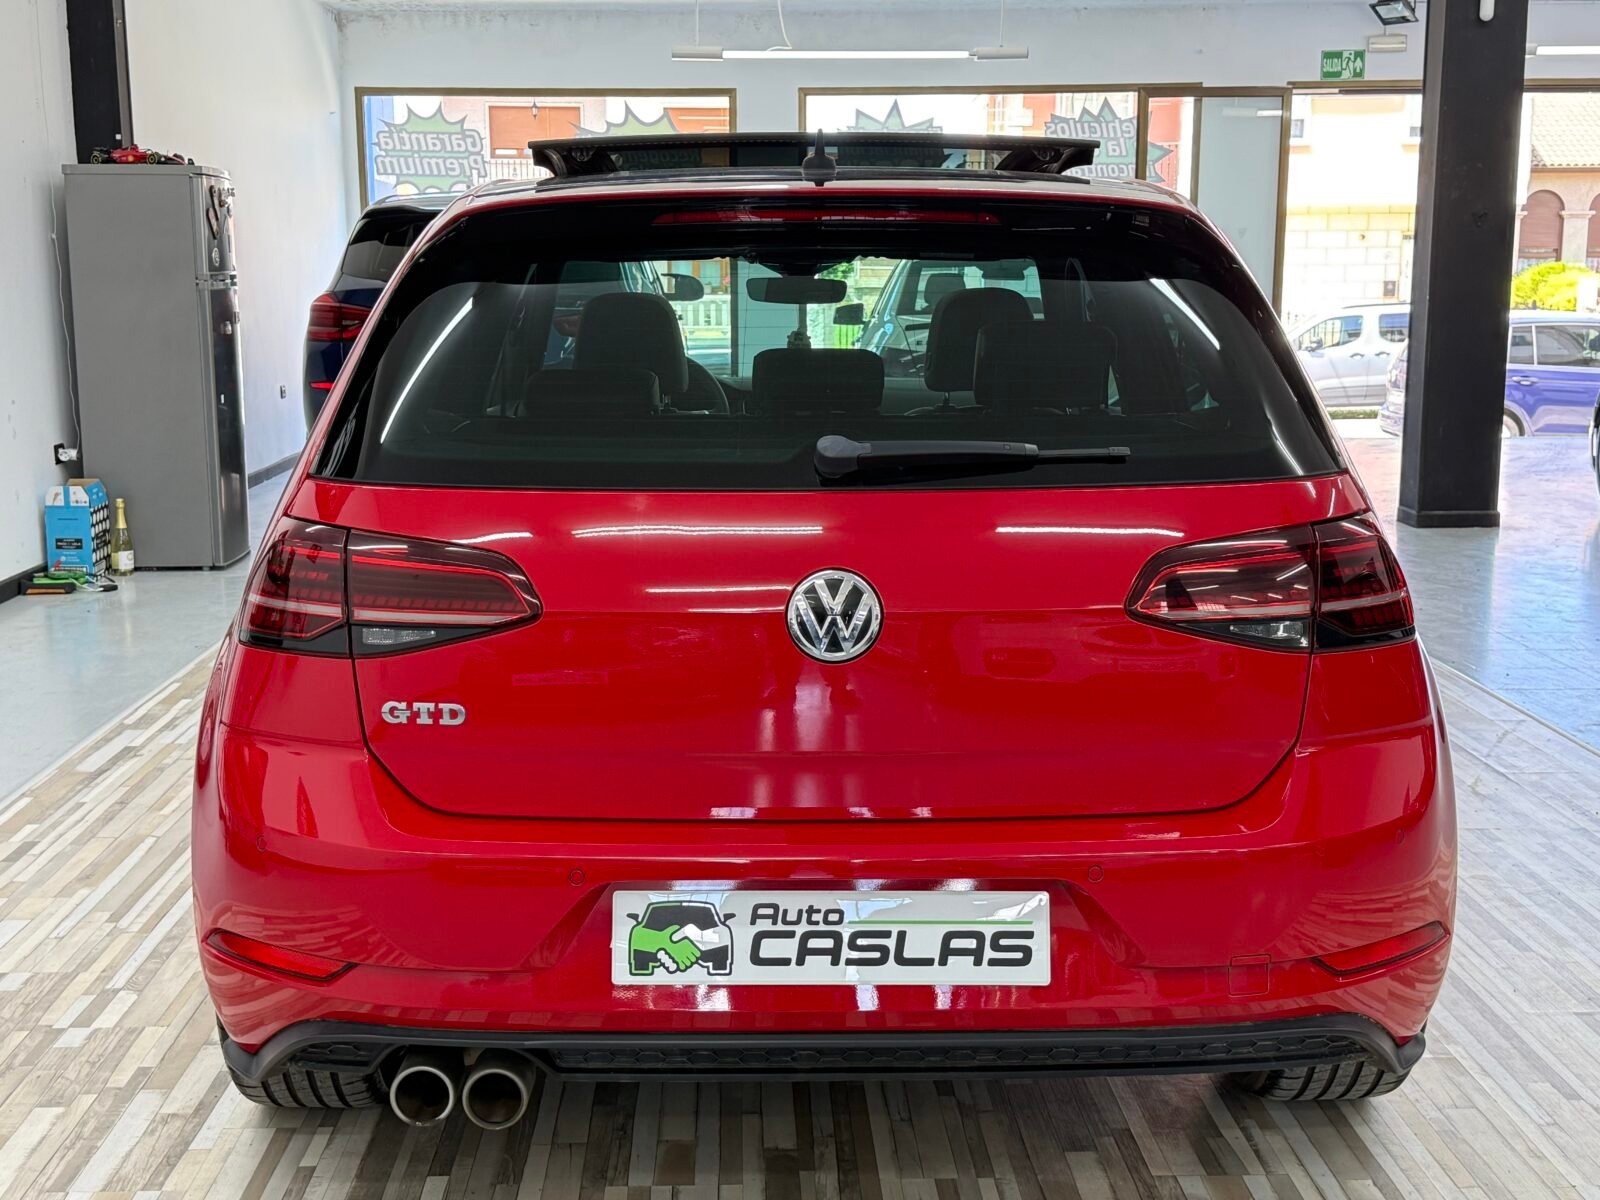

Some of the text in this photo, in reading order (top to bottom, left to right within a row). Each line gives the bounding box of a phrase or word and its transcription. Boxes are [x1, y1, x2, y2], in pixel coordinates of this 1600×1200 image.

[1323, 58, 1342, 72] SALIDA
[381, 701, 466, 726] GTD
[749, 902, 845, 926] Auto
[749, 929, 1035, 967] CASLAS
